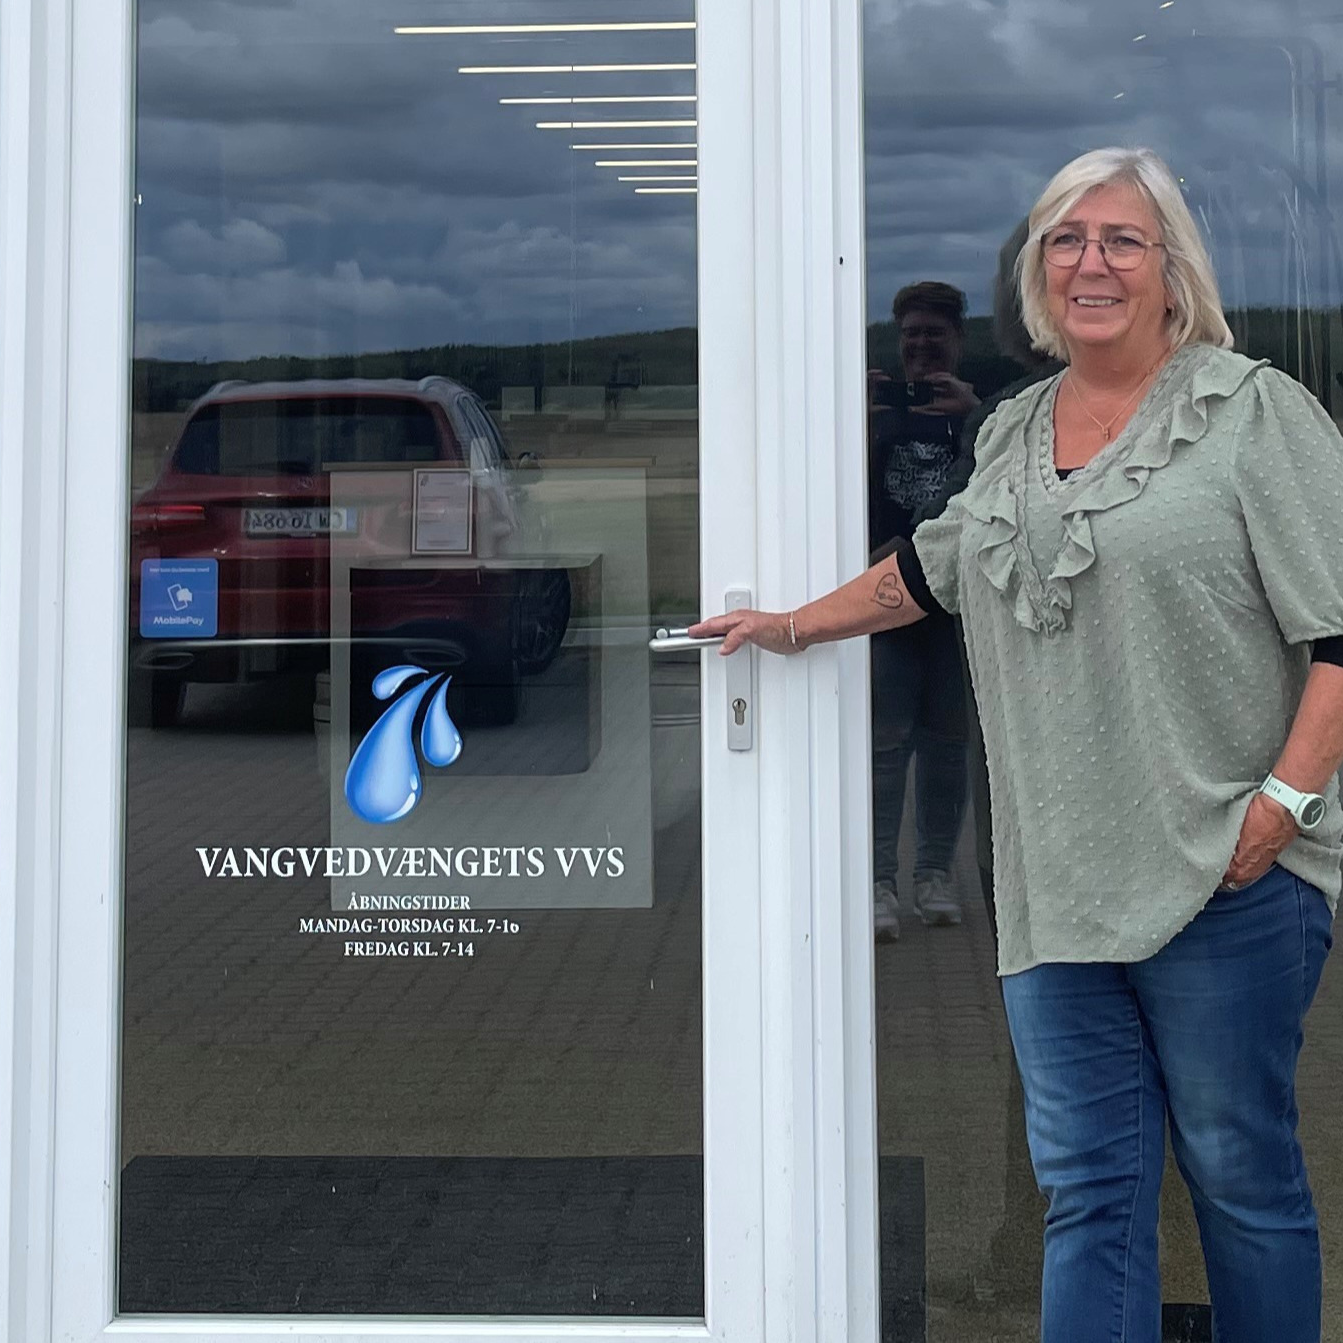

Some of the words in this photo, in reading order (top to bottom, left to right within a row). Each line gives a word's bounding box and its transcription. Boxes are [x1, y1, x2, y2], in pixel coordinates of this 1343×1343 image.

[152, 615, 205, 626] MobilePay
[195, 846, 546, 878] VANGVEDVÆNGETS
[553, 846, 625, 878] VVS
[346, 891, 471, 911] ÅBNINGSTIDER
[298, 917, 455, 935] MANDAG-TORSDAG
[457, 917, 484, 935] KL.
[343, 941, 410, 958] FREDAG
[412, 941, 439, 958] KL.
[441, 941, 475, 958] 7-14
